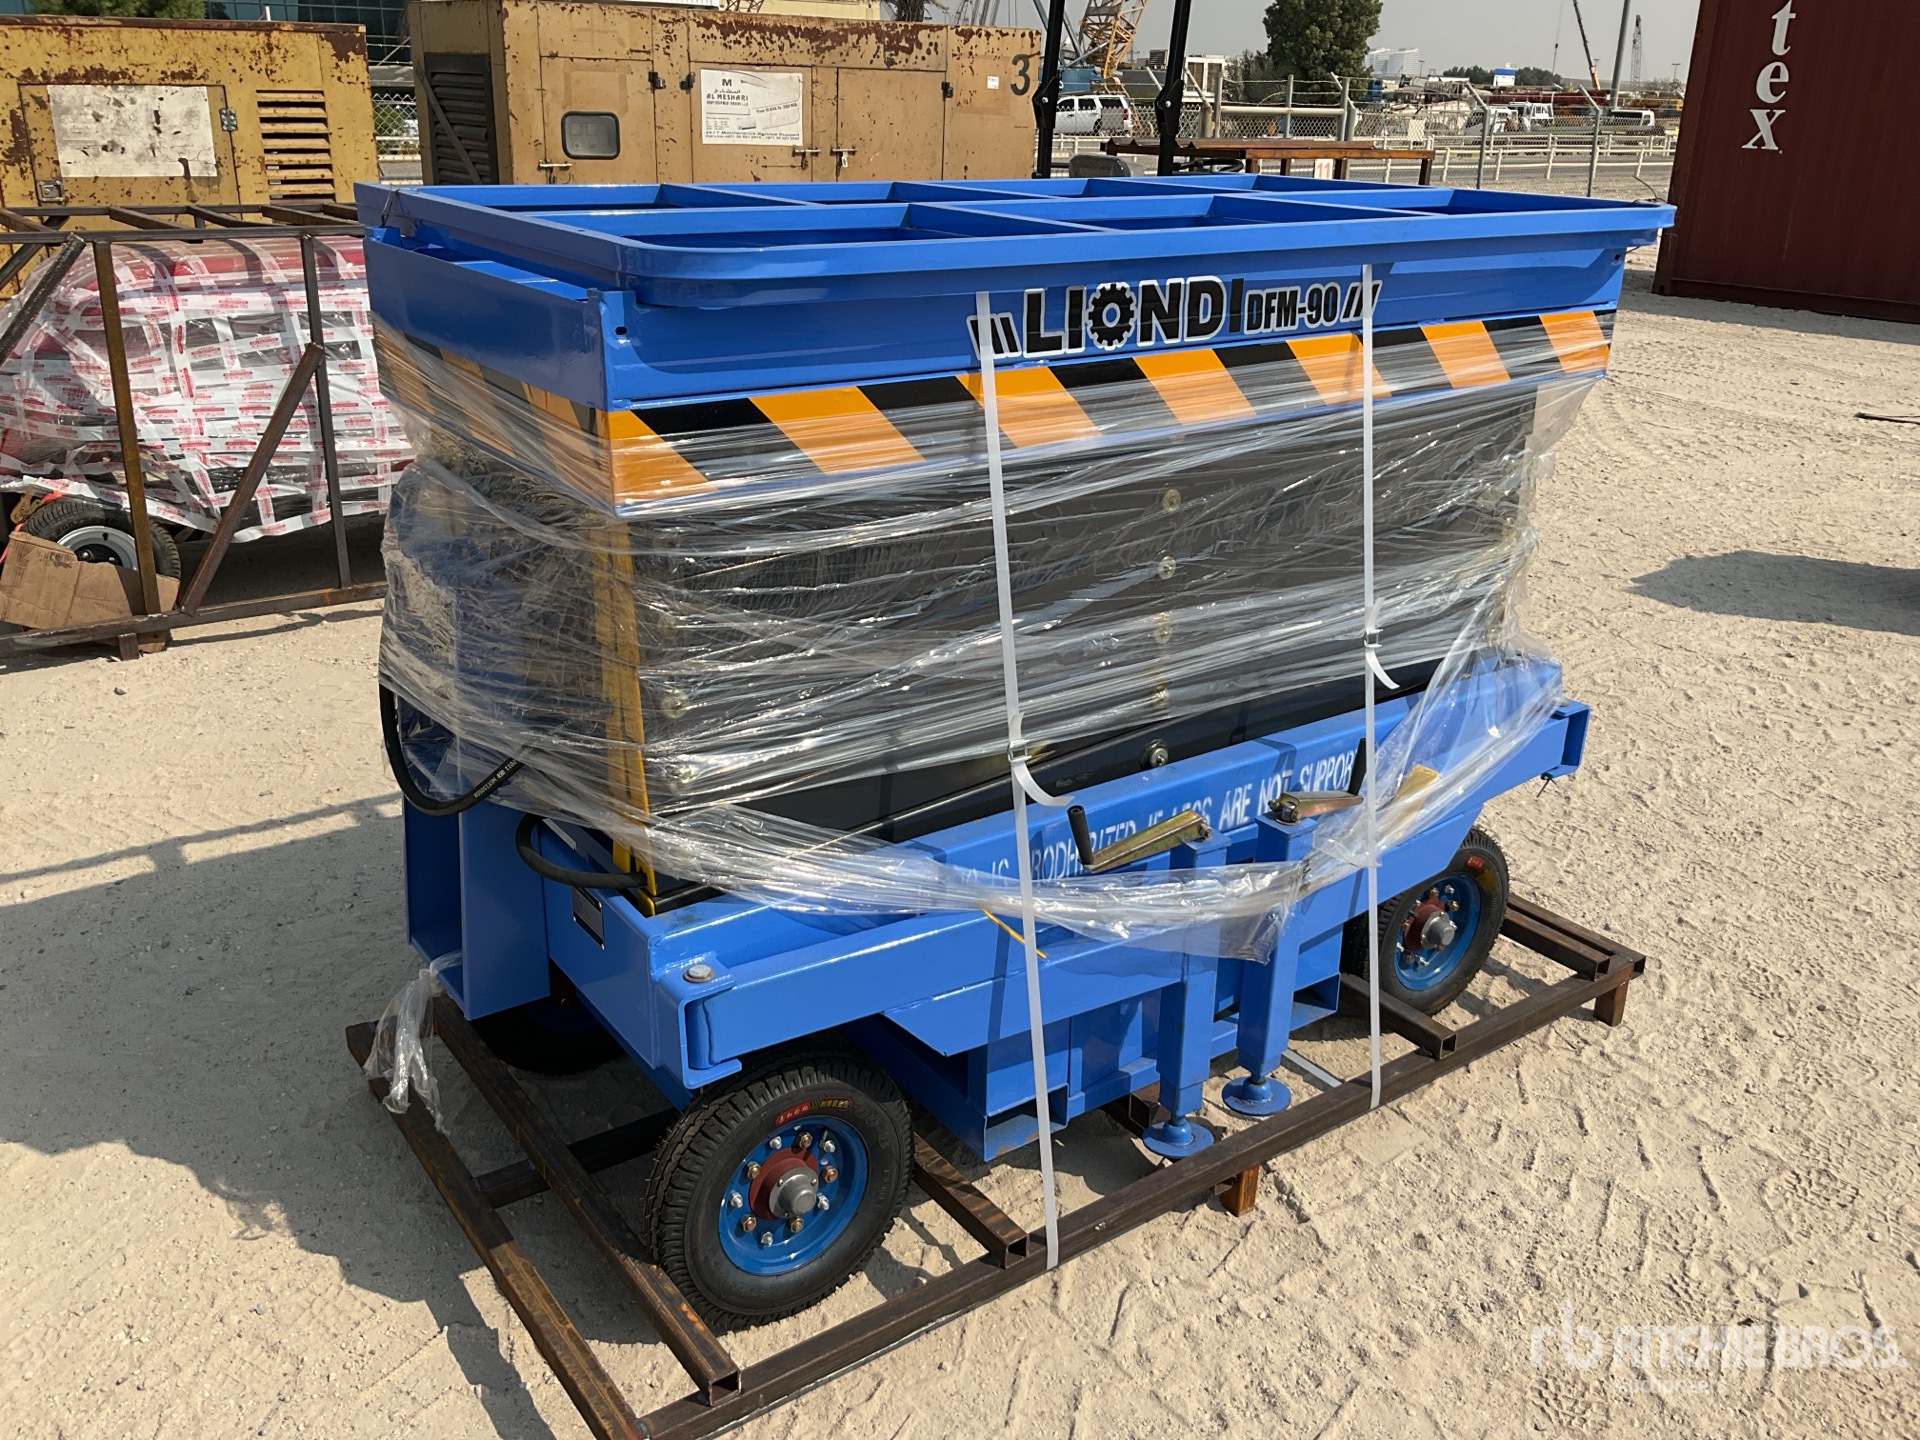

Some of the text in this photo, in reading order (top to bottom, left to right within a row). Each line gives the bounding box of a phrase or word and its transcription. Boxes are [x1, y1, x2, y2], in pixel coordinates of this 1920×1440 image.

[1010, 54, 1030, 96] 3
[1244, 282, 1341, 334] DFM-90
[1218, 783, 1253, 831] ARE
[1256, 769, 1294, 817] NOT
